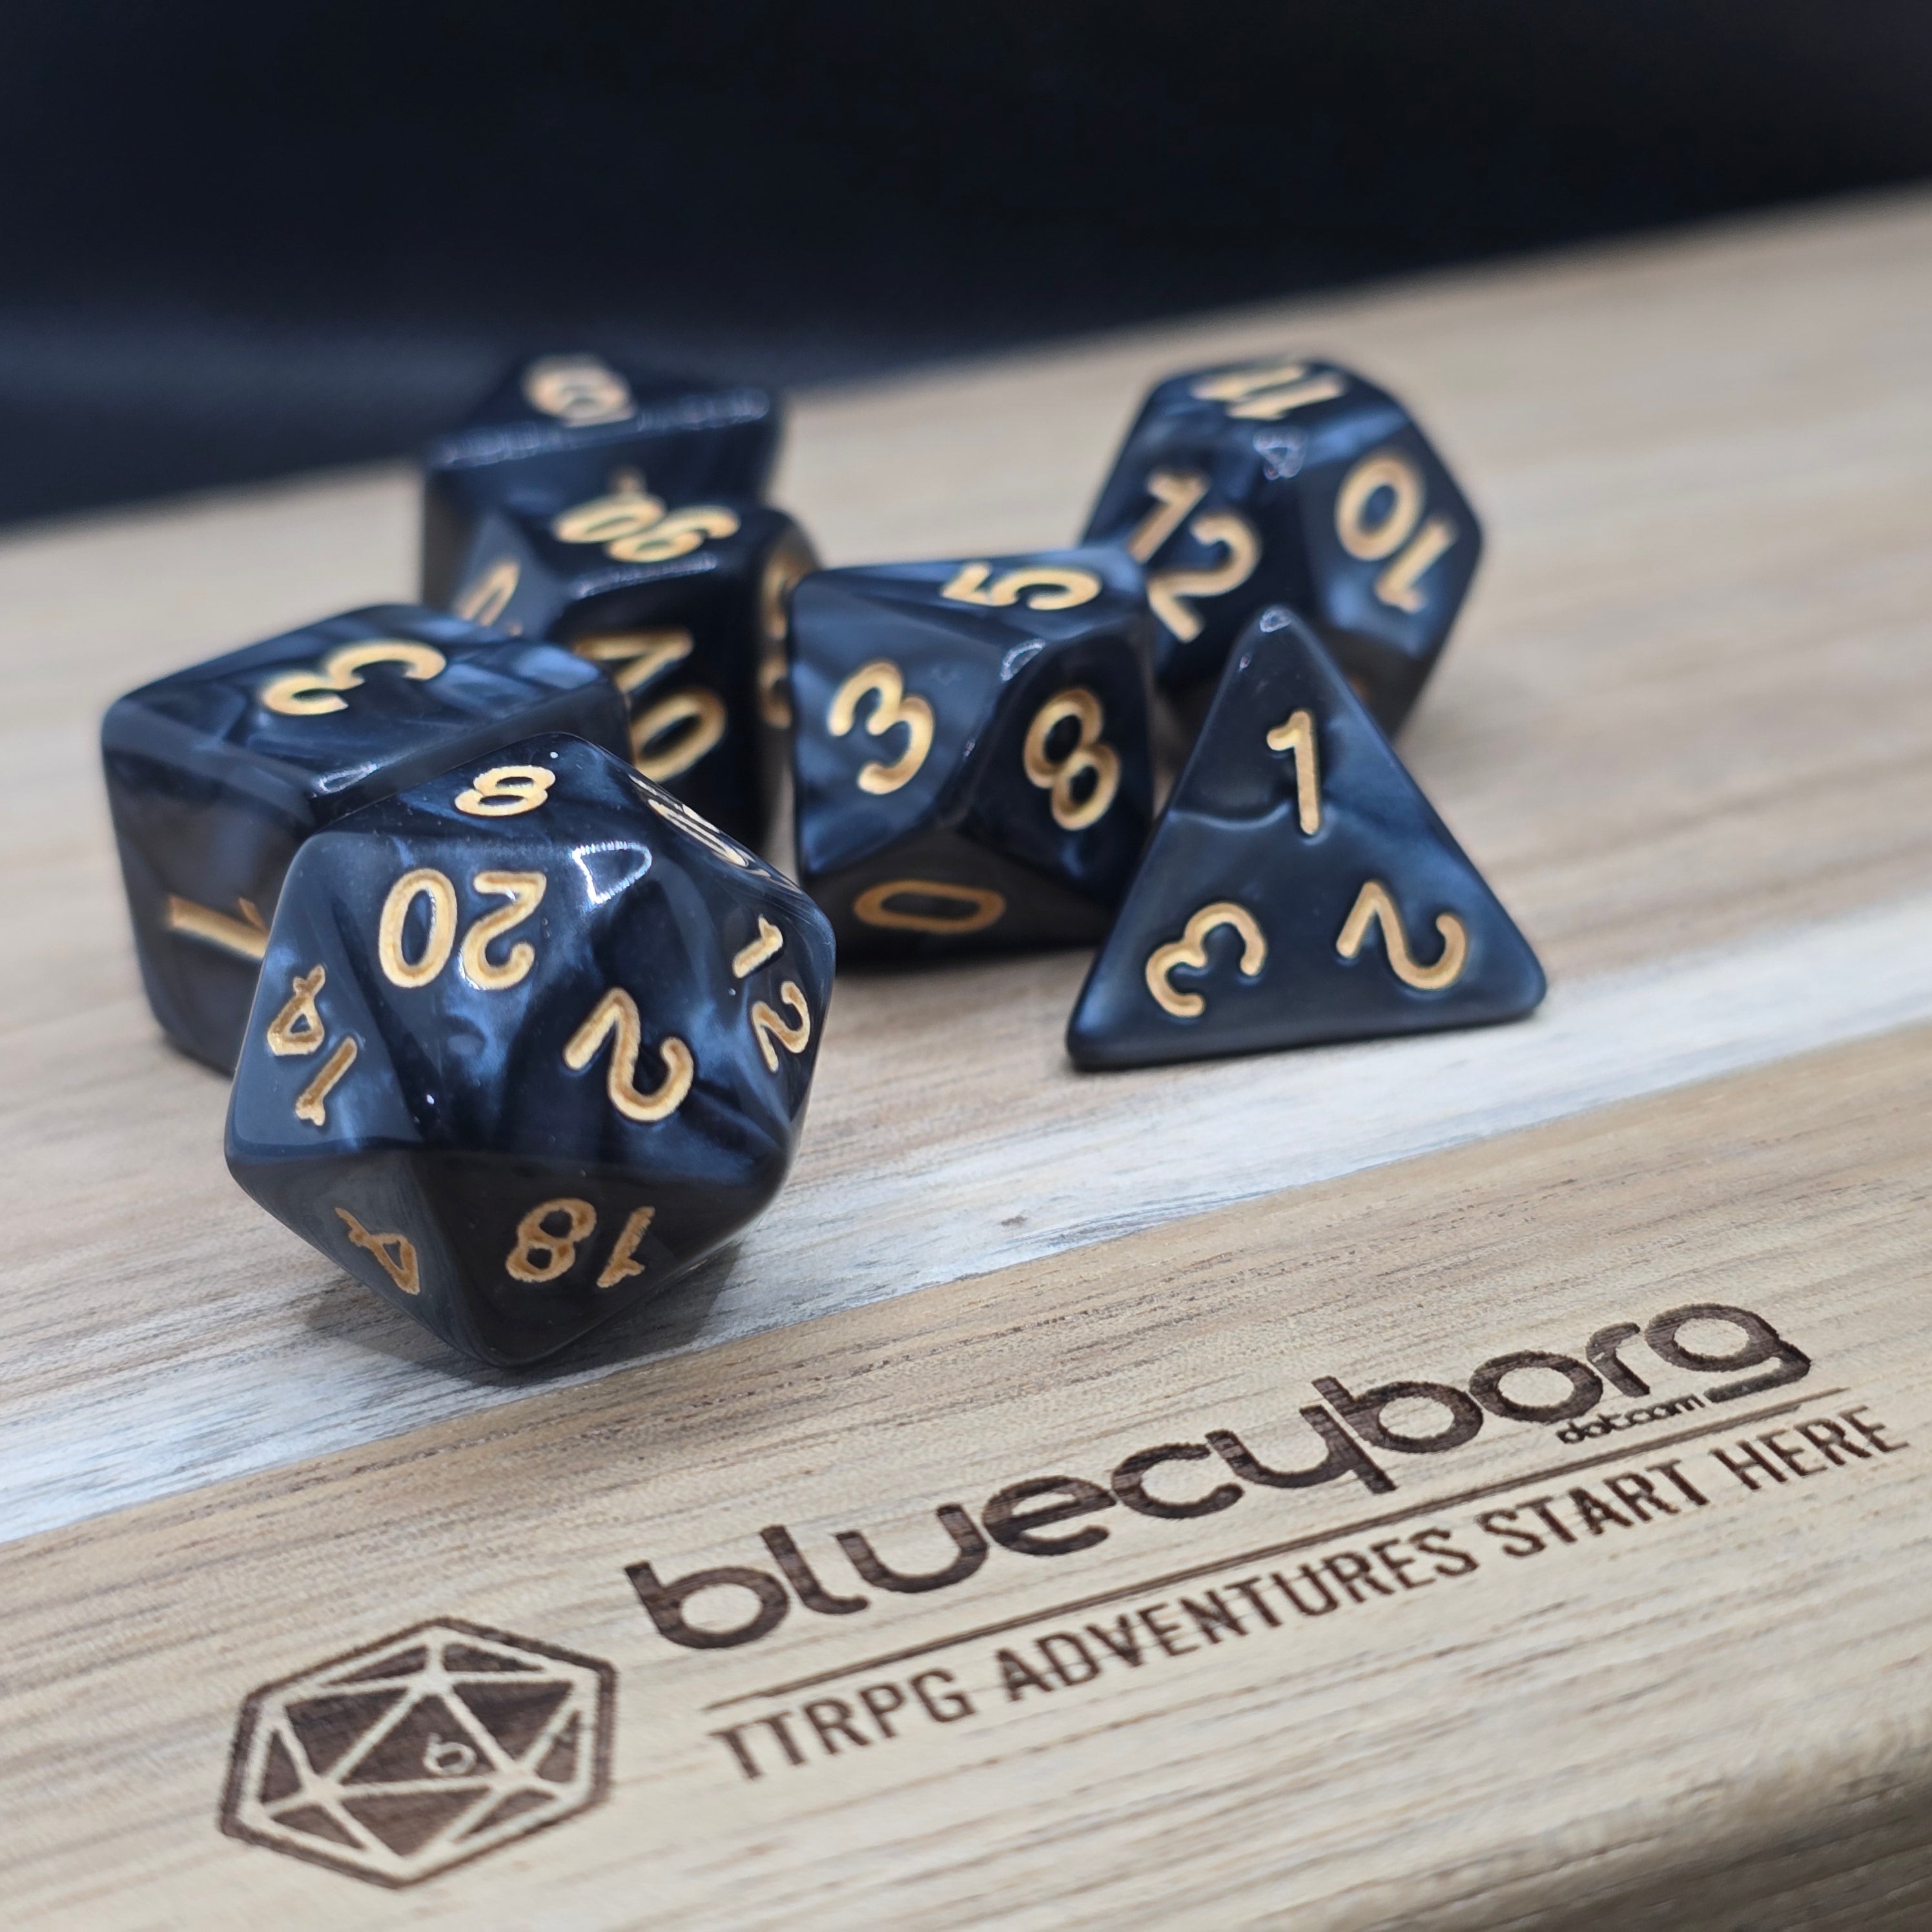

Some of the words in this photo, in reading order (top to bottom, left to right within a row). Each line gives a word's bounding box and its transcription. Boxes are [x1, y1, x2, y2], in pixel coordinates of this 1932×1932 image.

[940, 559, 1102, 612] 5
[260, 641, 447, 716] 3
[827, 659, 935, 796] 3
[454, 765, 556, 816] 8
[1023, 686, 1121, 832] 8
[1266, 710, 1321, 835] 1
[378, 868, 547, 990] 20
[1146, 901, 1269, 1018] 3
[1336, 880, 1466, 991] 2
[730, 913, 812, 1073] 12
[564, 987, 695, 1123] 2
[505, 1197, 655, 1289] 18
[624, 1303, 1811, 1649] bluecyborg
[708, 1667, 979, 1780] TTRPG
[994, 1528, 1480, 1702] ADVENTURES
[1475, 1459, 1710, 1558] START
[1708, 1405, 1910, 1491] HERE
